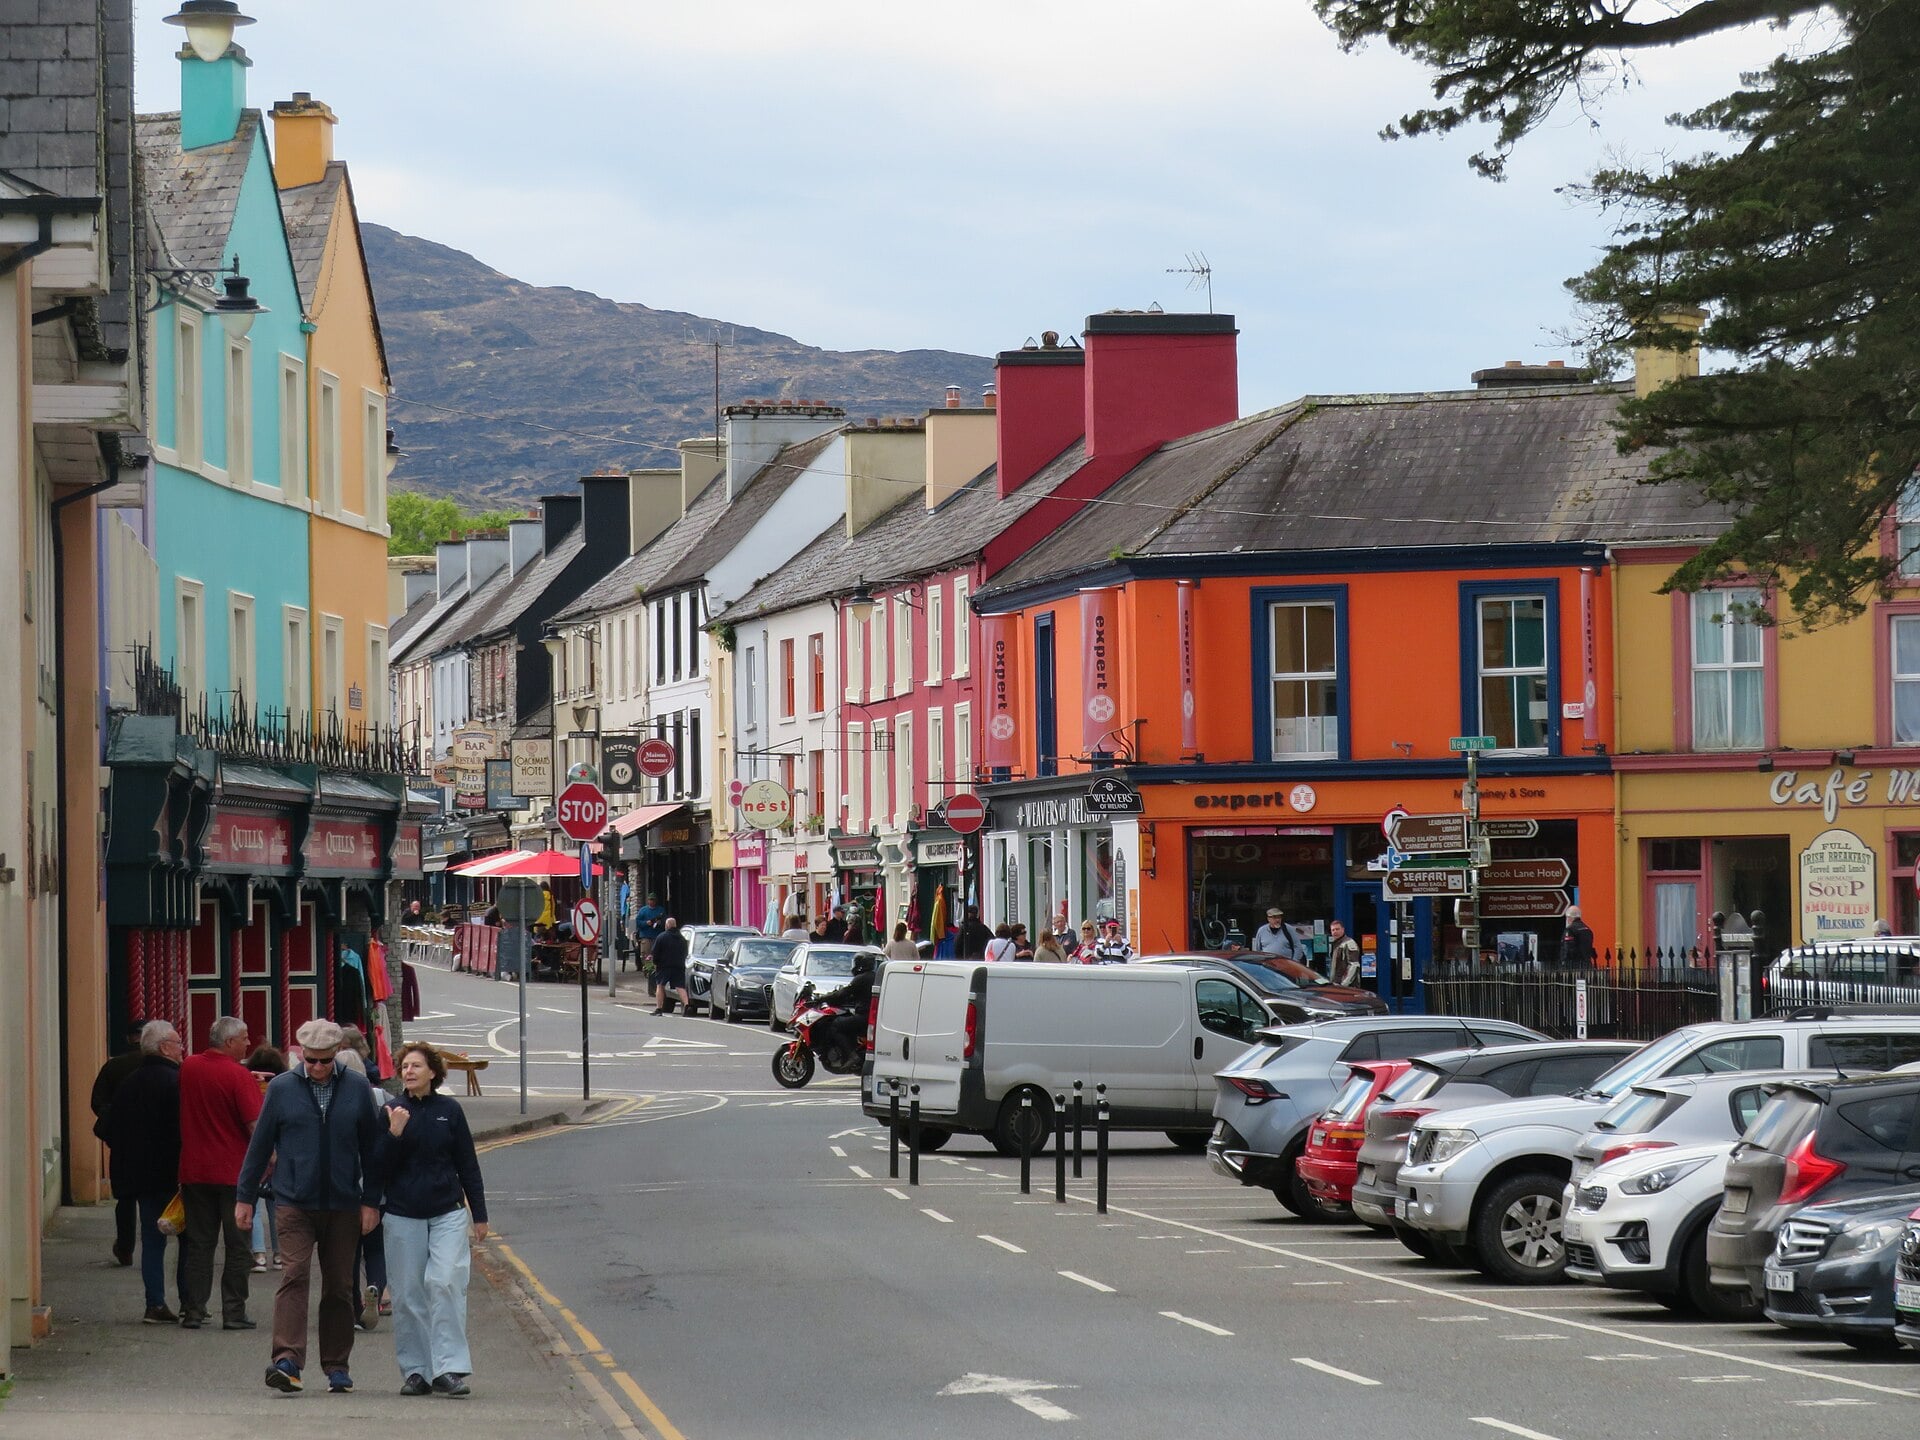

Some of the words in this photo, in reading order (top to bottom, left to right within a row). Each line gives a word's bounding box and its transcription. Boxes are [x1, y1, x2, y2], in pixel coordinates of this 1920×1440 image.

[1093, 615, 1107, 690] expert
[995, 640, 1008, 710] expert
[464, 741, 487, 751] BAR
[605, 743, 637, 754] FATFACE
[1451, 740, 1467, 750] New
[1469, 739, 1485, 749] York
[455, 756, 486, 765] RESTAURA
[521, 766, 547, 776] HOTEL
[461, 773, 479, 782] BED
[1091, 793, 1134, 803] WEAVERS
[1510, 788, 1517, 798] &
[1520, 788, 1546, 798] Sons
[1770, 769, 1872, 824] Café
[744, 799, 787, 812] nest
[1194, 791, 1284, 811] expert
[560, 799, 605, 823] STOP
[1024, 799, 1058, 828] WEAVERS
[1059, 805, 1067, 821] OF
[1821, 842, 1852, 851] FULL
[1803, 852, 1824, 866] IRISH
[1828, 851, 1871, 865] BREAKFAST
[1484, 869, 1511, 878] Brook
[1513, 869, 1536, 877] Lane
[1537, 868, 1563, 877] Hotel
[1809, 865, 1830, 873] Served
[1832, 865, 1846, 873] until
[1848, 865, 1866, 873] Lunch
[1402, 872, 1446, 882] SEAFARI
[1805, 900, 1870, 915] SMOOTHIES
[1817, 915, 1866, 930] MILKSHAKES
